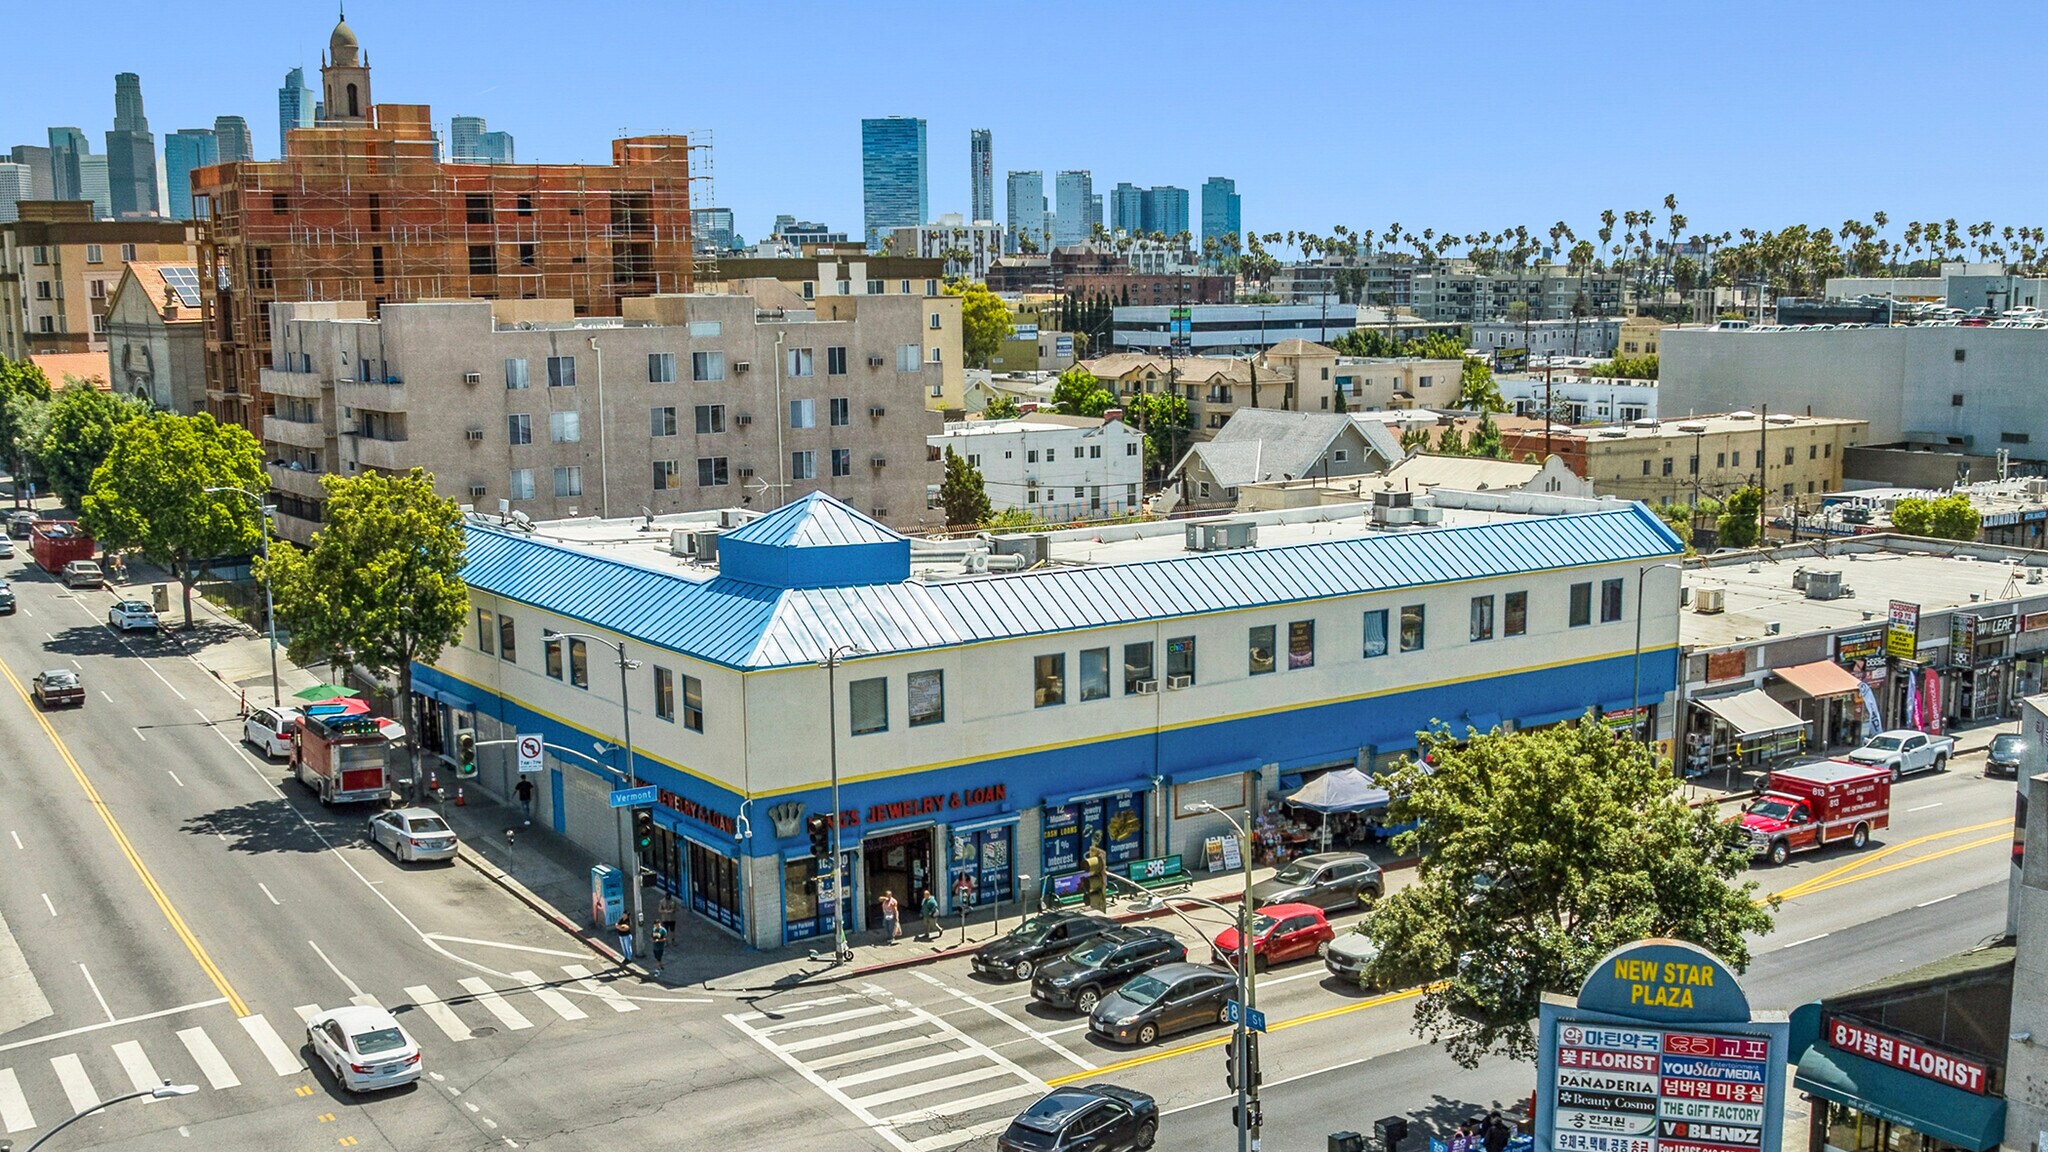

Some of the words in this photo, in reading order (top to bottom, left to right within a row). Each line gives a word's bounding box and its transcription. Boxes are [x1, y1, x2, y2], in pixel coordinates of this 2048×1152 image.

[1992, 617, 2014, 633] LEAF
[615, 791, 652, 802] Vermont
[1846, 788, 1856, 796] LOS
[867, 794, 945, 823] JEWELRY
[949, 792, 961, 809] &
[964, 784, 1007, 806] LOAN
[1851, 801, 1877, 811] DEPARTMENT
[707, 810, 734, 835] LOAN
[1614, 959, 1659, 982] NEW
[1663, 962, 1714, 987] STAR
[1631, 984, 1694, 1009] PLAZA
[1252, 1014, 1264, 1027] St
[1719, 1038, 1766, 1060] 교포
[1835, 1024, 1894, 1062] 8가꽃집
[1898, 1044, 1982, 1090] FLORIST
[1561, 1049, 1578, 1065] 꽃
[1581, 1051, 1656, 1071] FLORIST
[1710, 1060, 1760, 1071] Entertainment
[1560, 1075, 1654, 1094] PANADERIA
[1664, 1079, 1712, 1098] 넘버원
[1716, 1083, 1764, 1103] 미용실
[1573, 1093, 1613, 1110] Beauty
[1614, 1097, 1656, 1111] Cosmo
[1663, 1101, 1684, 1115] THE
[1686, 1103, 1710, 1118] GIFT
[1712, 1105, 1760, 1122] FACTORY
[1589, 1114, 1626, 1128] 한의원
[1453, 1138, 1467, 1147] 20
